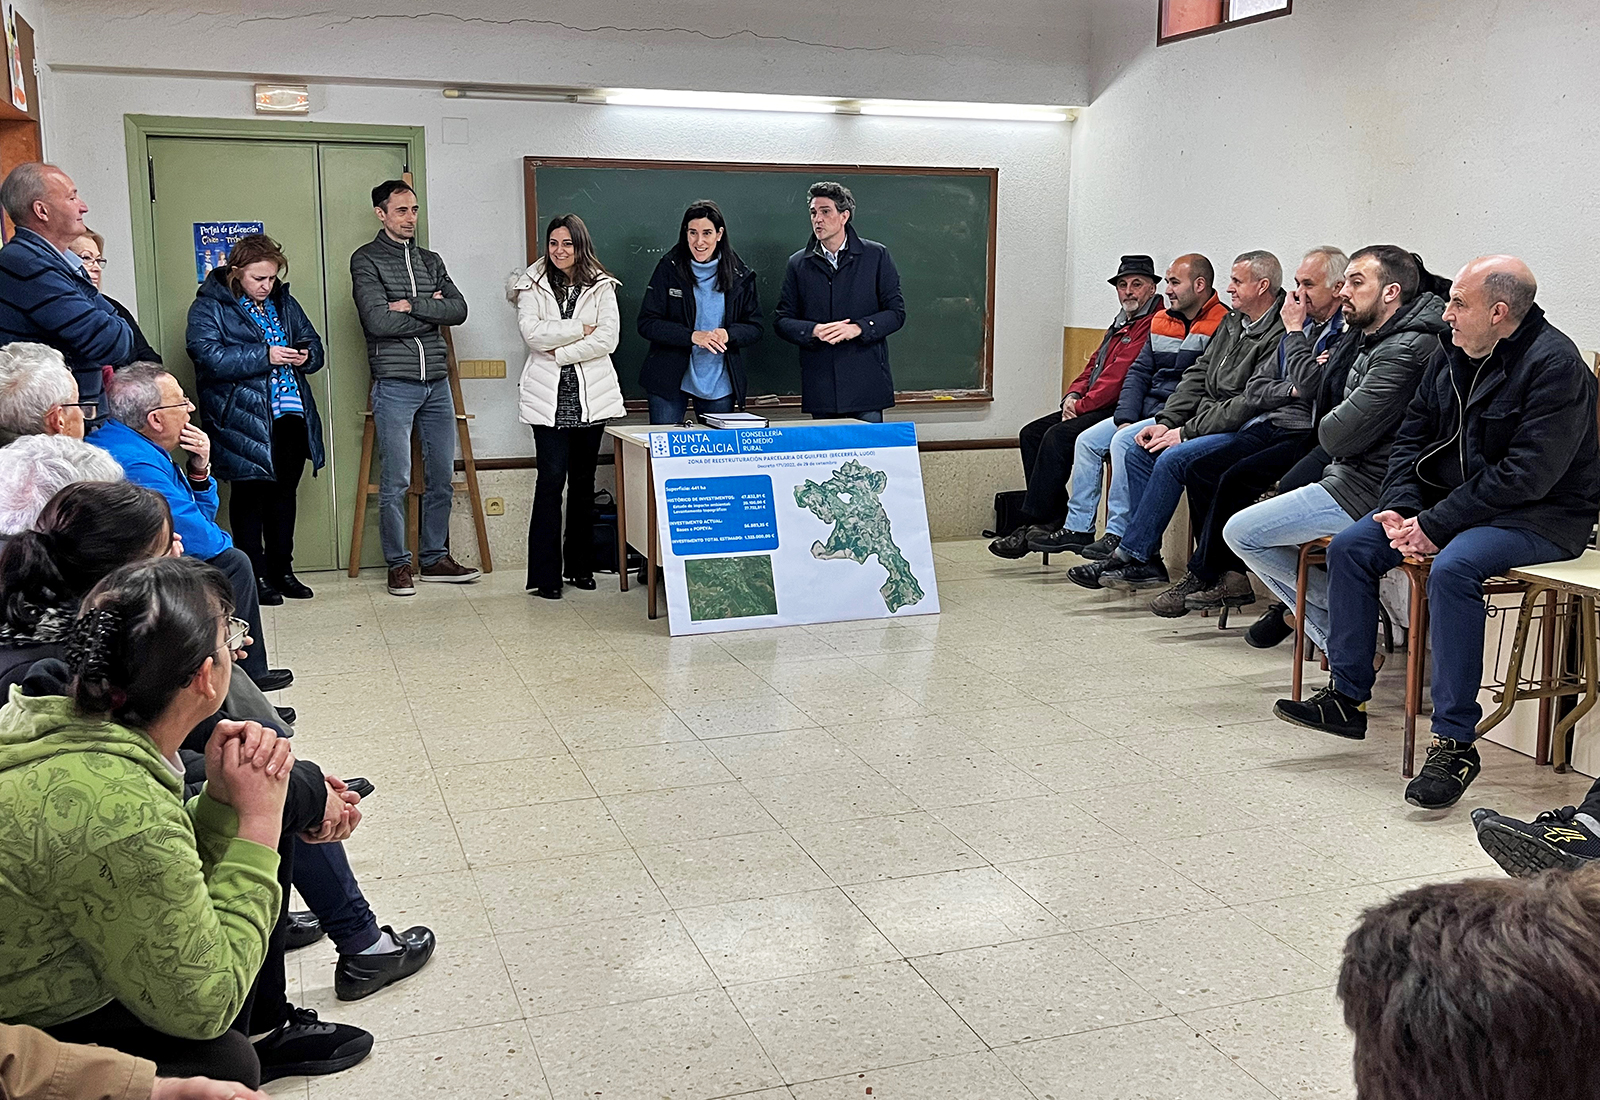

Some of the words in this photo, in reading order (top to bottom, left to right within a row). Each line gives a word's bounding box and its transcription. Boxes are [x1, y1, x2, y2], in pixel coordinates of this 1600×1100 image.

[200, 225, 220, 236] Portal
[220, 225, 228, 233] de
[672, 433, 710, 444] XUNTA
[741, 430, 783, 438] CONSELLERÍA
[752, 437, 774, 445] MEDIO
[672, 446, 688, 455] DE
[690, 443, 735, 454] GALICIA
